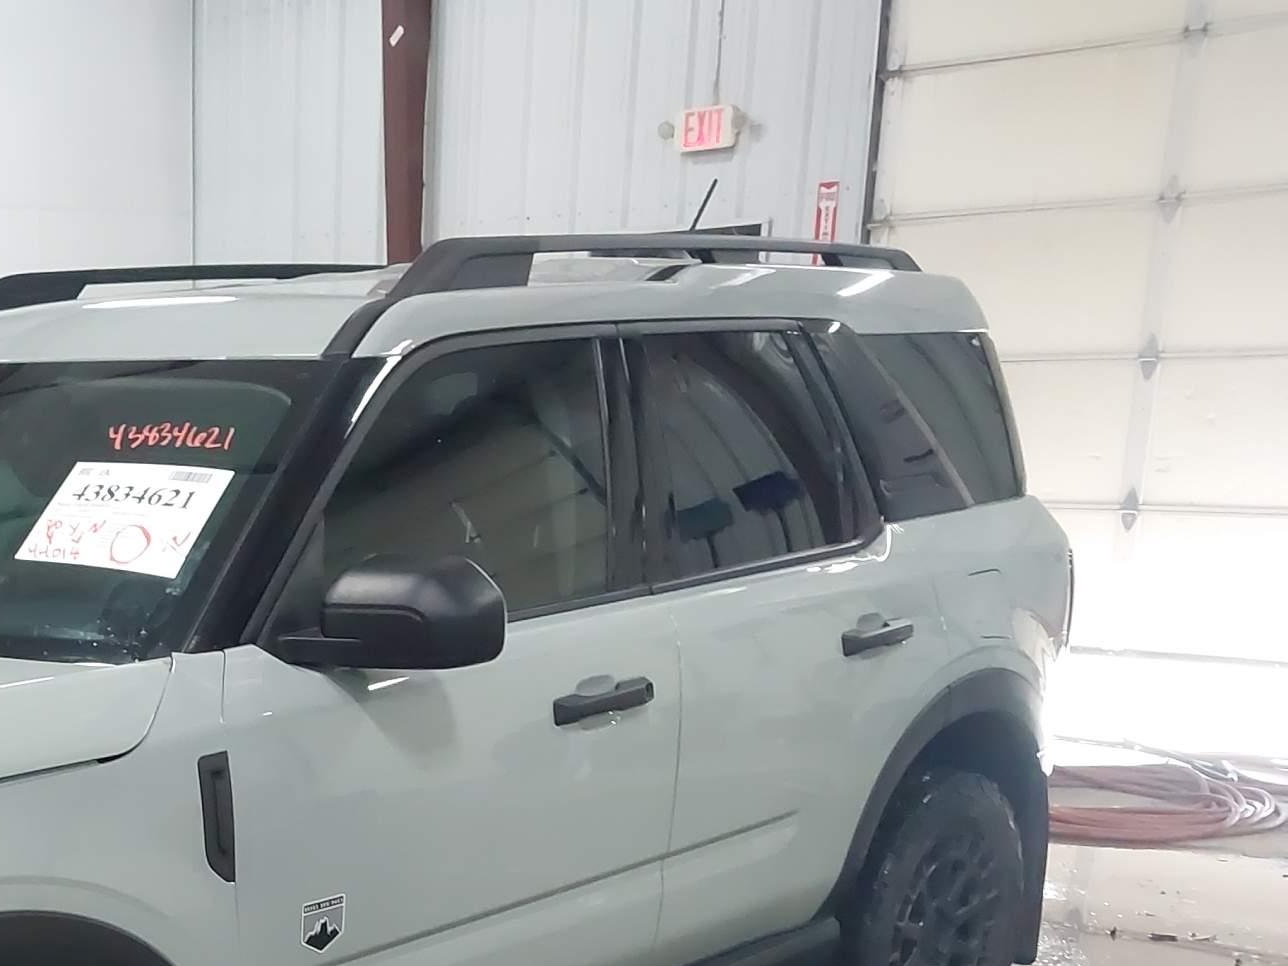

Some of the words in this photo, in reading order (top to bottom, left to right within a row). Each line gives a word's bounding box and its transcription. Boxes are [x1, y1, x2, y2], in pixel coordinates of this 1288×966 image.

[683, 108, 724, 148] EXIT
[109, 422, 236, 451] 43834621
[71, 484, 197, 510] 43834621
